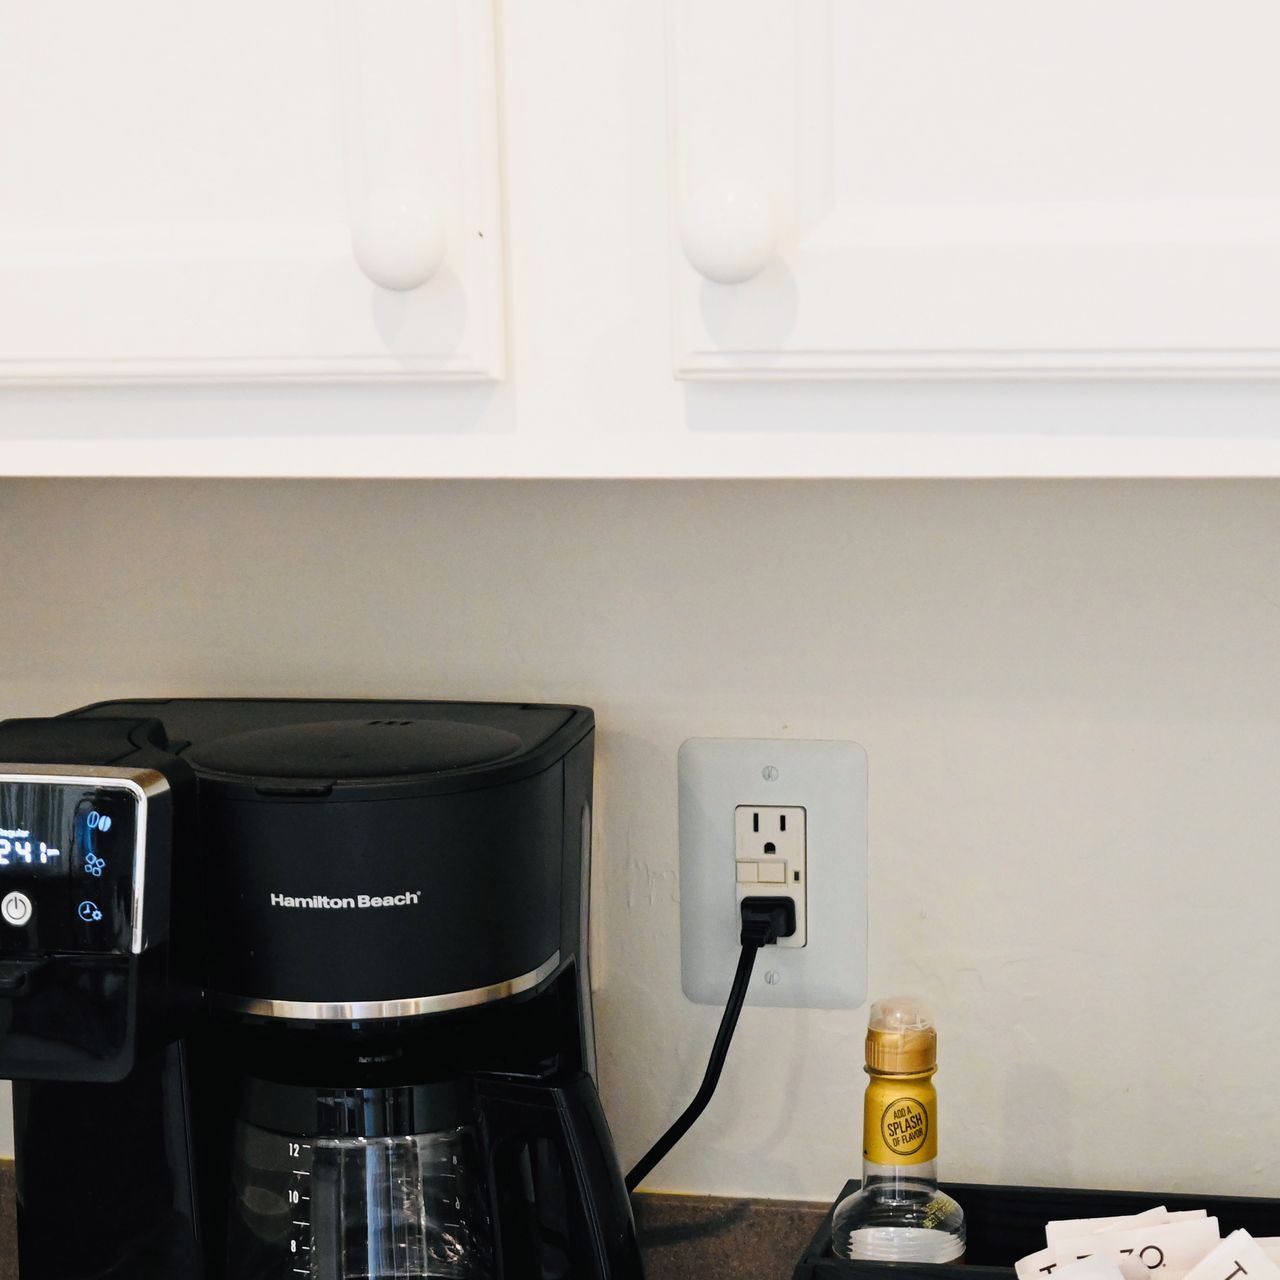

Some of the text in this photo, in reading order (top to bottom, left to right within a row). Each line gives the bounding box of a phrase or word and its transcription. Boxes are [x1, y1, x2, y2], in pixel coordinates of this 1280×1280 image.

[270, 891, 418, 908] Hamilton Beach
[893, 1106, 913, 1121] ADD A
[887, 1113, 923, 1137] SPLASH
[893, 1136, 901, 1147] OF
[289, 1143, 299, 1157] 12
[288, 1191, 298, 1204] 10
[290, 1240, 296, 1252] 8
